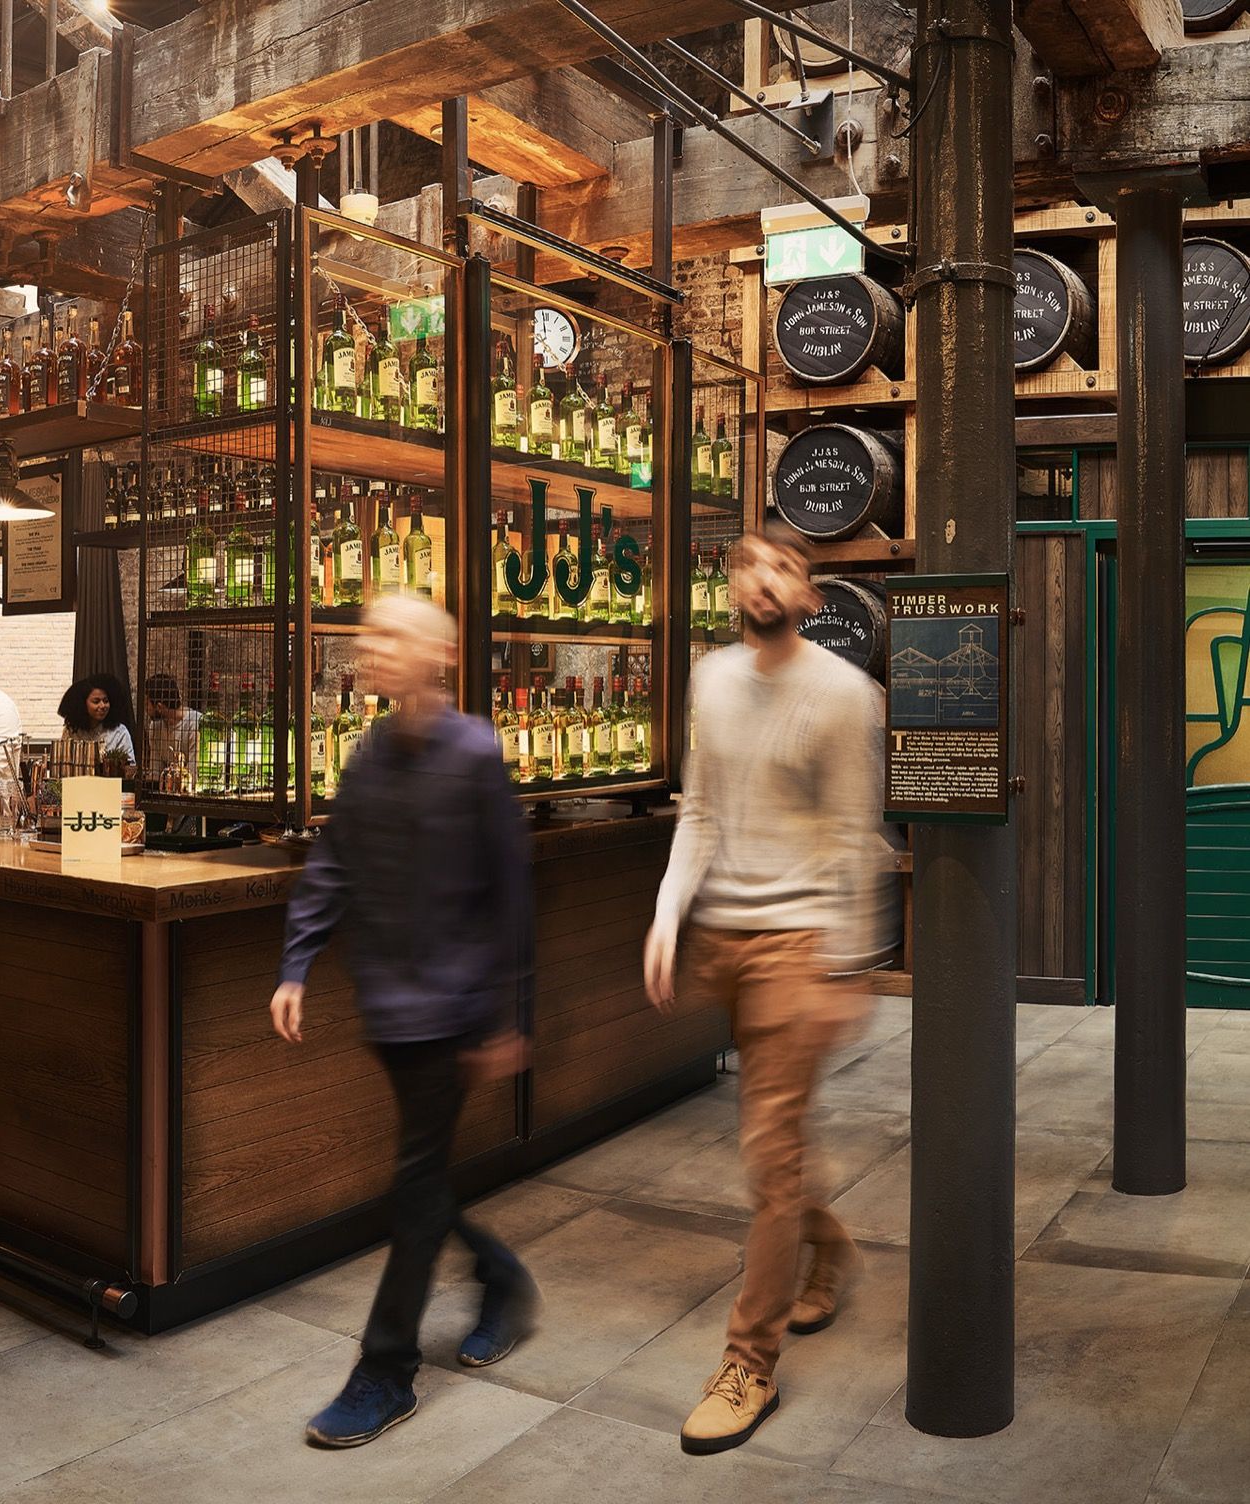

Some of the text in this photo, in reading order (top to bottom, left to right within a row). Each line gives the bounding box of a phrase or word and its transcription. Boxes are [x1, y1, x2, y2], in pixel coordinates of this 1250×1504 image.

[1183, 275, 1220, 287] AMESON
[1045, 291, 1061, 312] SON
[1194, 300, 1228, 310] STREET
[784, 310, 805, 331] JOHN
[806, 302, 846, 315] JAMESON
[852, 308, 868, 328] SON
[820, 325, 851, 335] STREET
[1184, 319, 1220, 333] UBLIN
[802, 342, 842, 357] DUBLIN
[784, 466, 804, 488] JOHN
[845, 464, 850, 473] &
[851, 465, 868, 485] SON
[820, 482, 850, 492] STREET
[805, 499, 843, 513] DUBLIN
[504, 476, 642, 608] JJ's
[892, 595, 946, 605] TIMBER
[892, 604, 999, 615] TRUSSWORK
[805, 616, 843, 628] JAMESON
[851, 621, 867, 640] SON
[70, 811, 113, 832] JJ's
[246, 879, 282, 898] Kelly
